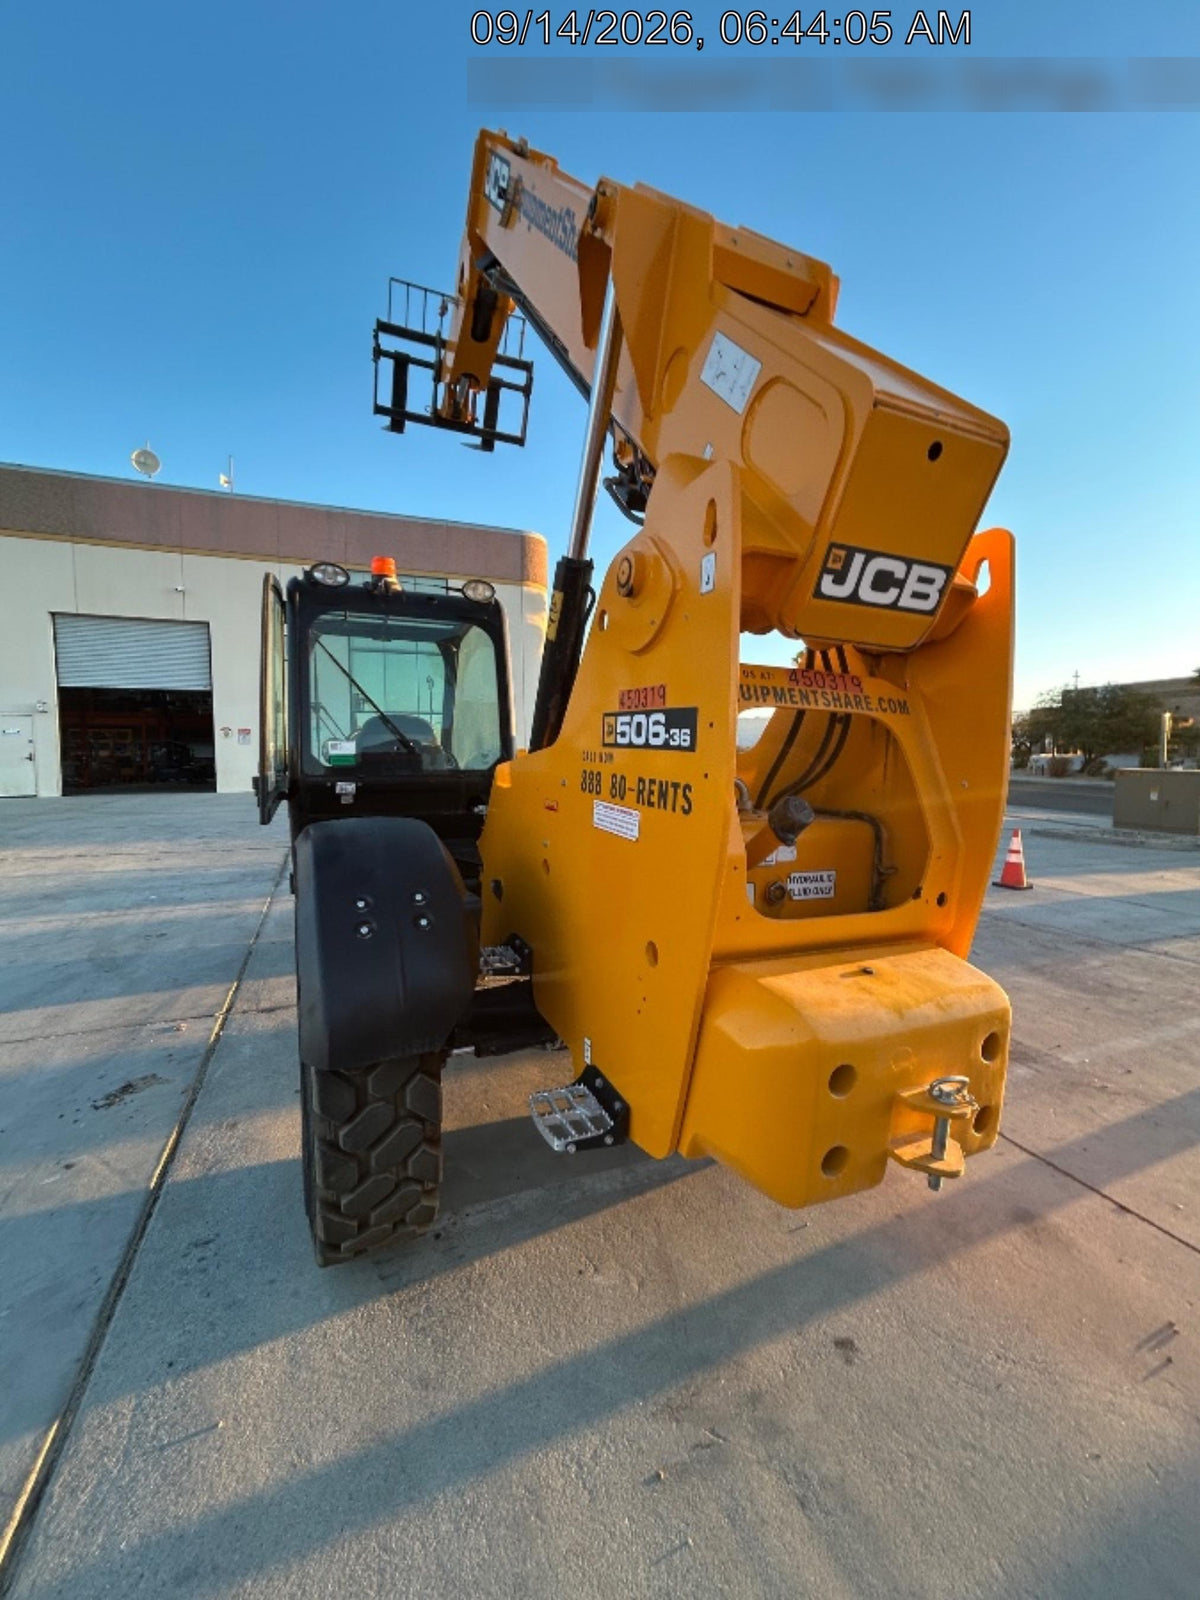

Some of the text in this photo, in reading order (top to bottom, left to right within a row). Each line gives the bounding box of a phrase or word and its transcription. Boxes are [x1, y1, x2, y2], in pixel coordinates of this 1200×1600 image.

[820, 552, 947, 611] JCB
[619, 684, 666, 709] 450319
[788, 669, 864, 694] 450319
[738, 683, 910, 715] UIPMENTSHARE.COM
[581, 769, 693, 816] 888 80-RENTS
